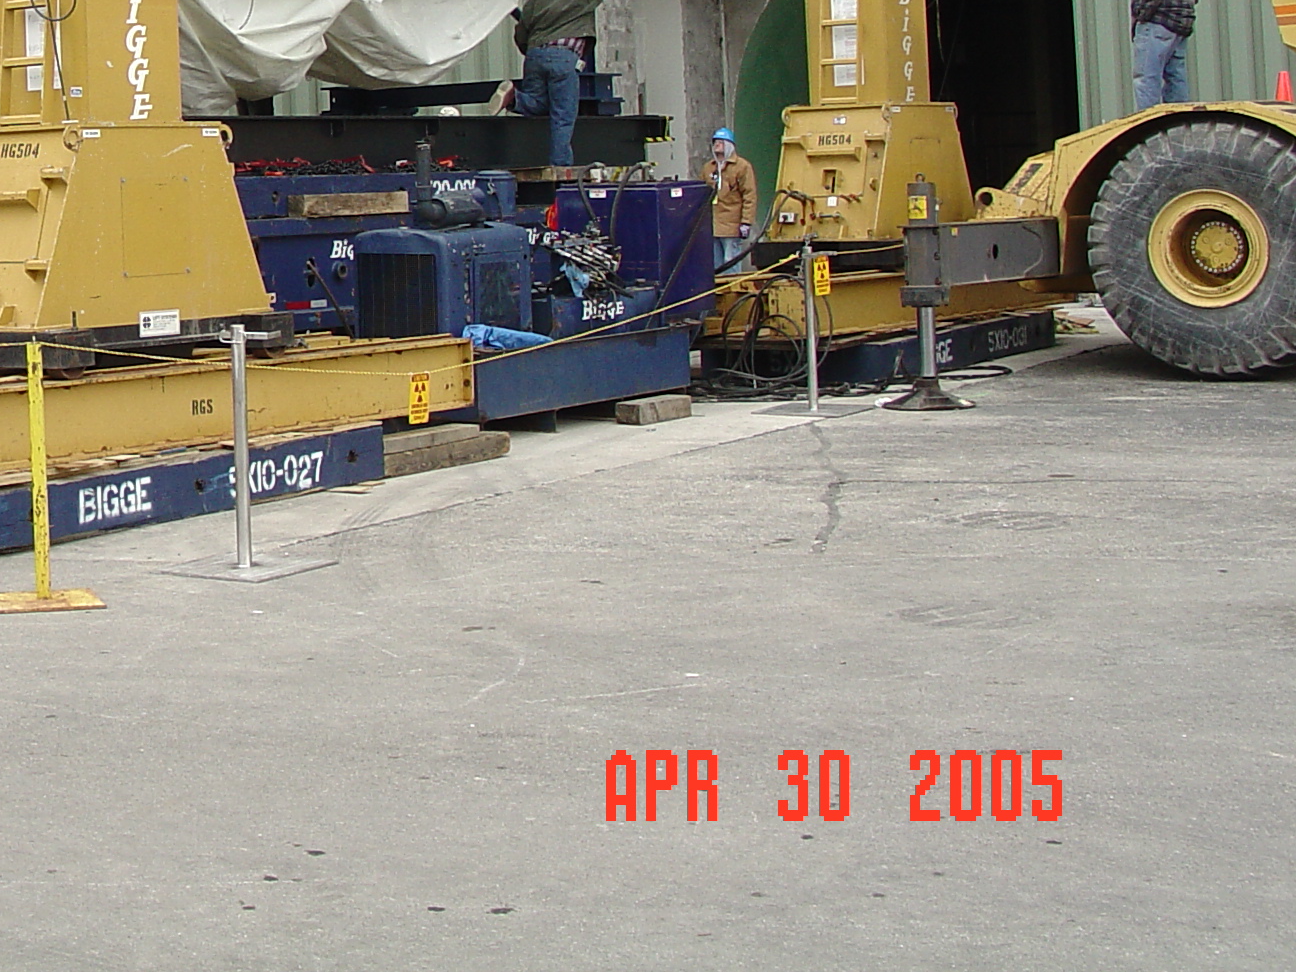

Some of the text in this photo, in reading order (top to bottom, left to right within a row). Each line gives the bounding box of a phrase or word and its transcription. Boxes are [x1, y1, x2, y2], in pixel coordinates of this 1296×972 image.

[817, 134, 852, 147] HG504
[0, 142, 40, 159] HG504
[191, 398, 214, 417] RGS
[78, 475, 152, 525] BIGGE
